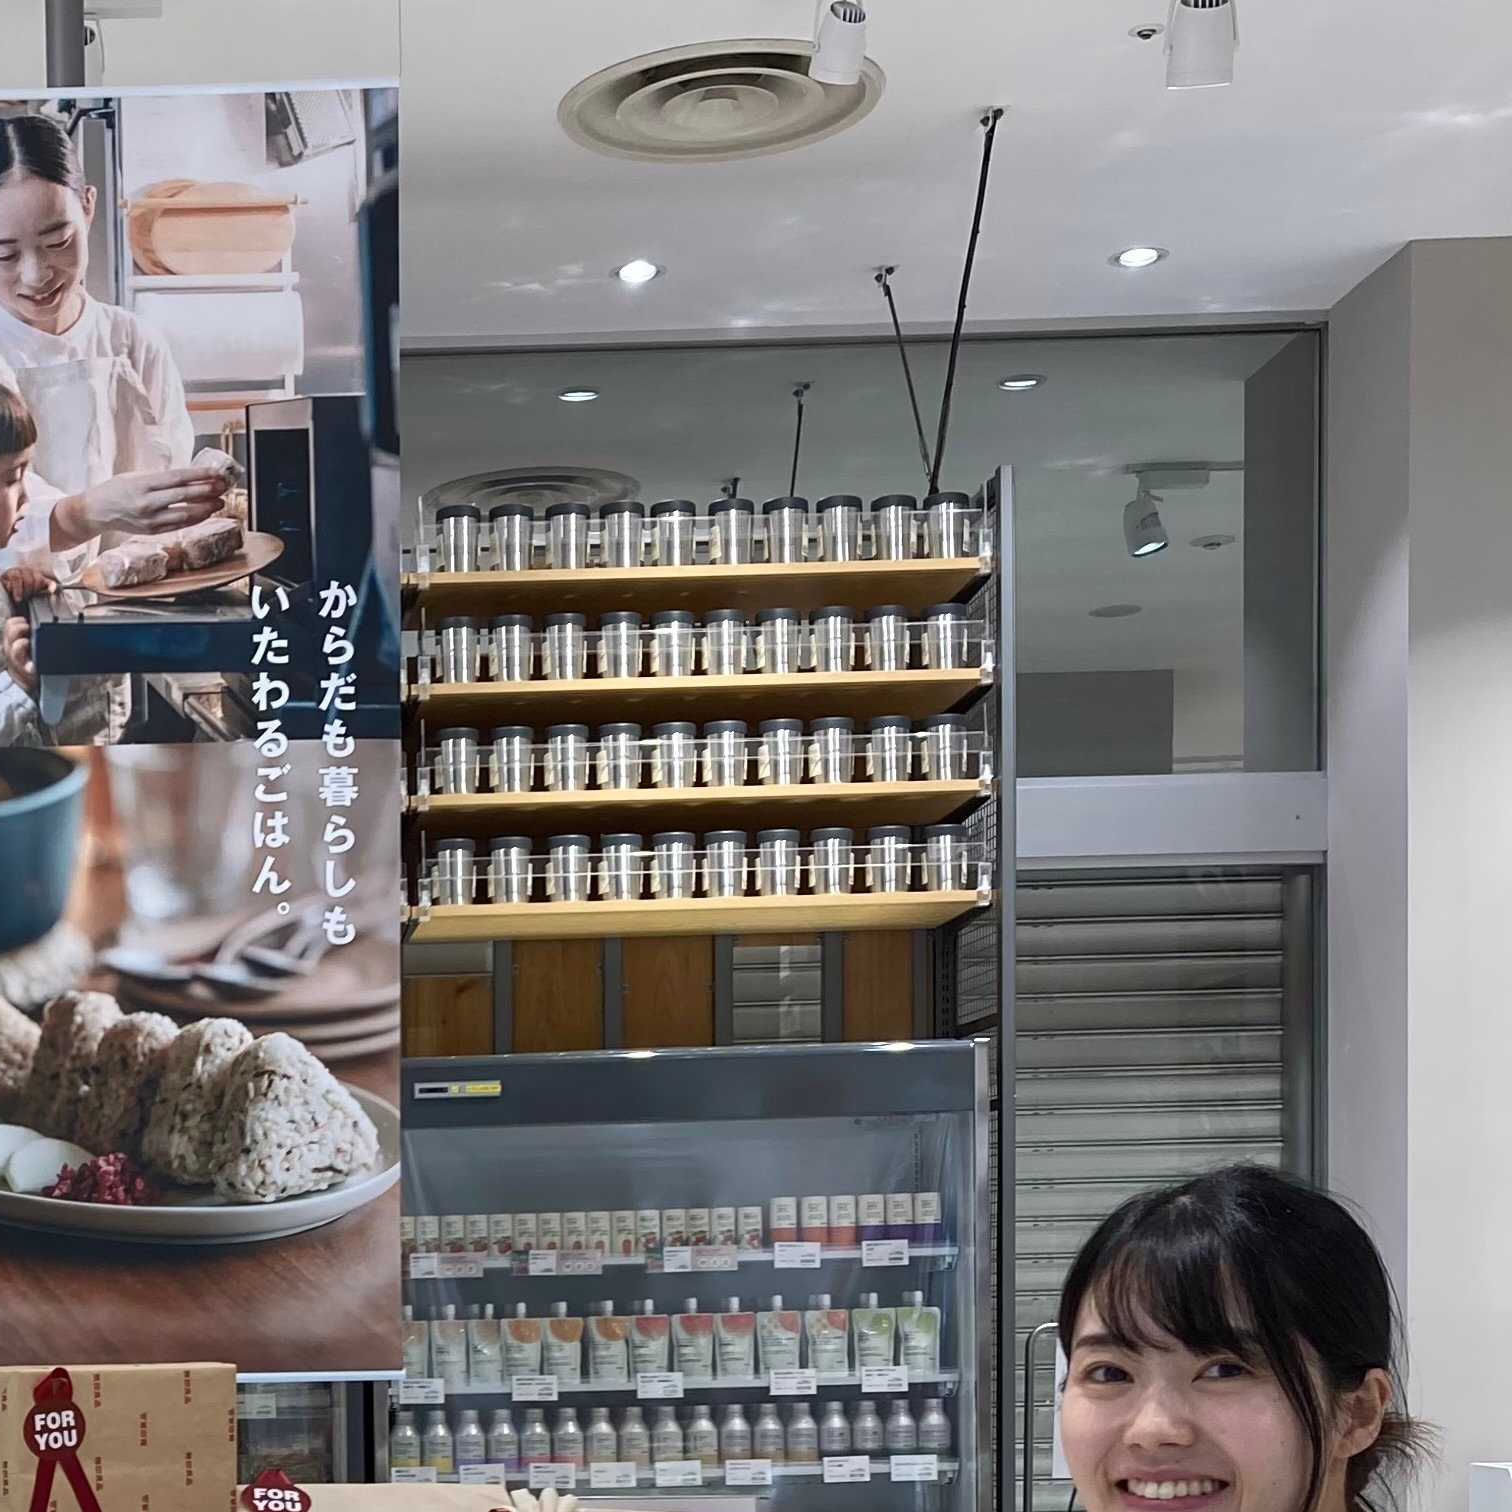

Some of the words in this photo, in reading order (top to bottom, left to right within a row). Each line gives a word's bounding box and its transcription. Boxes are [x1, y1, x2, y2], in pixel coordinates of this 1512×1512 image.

[250, 584, 291, 916] いたわるごはん。
[318, 580, 359, 946] からだも暮らしも
[34, 1410, 76, 1431] FOR
[34, 1429, 77, 1451] YOU
[253, 1487, 301, 1502] FOR
[252, 1499, 303, 1512] YOU
